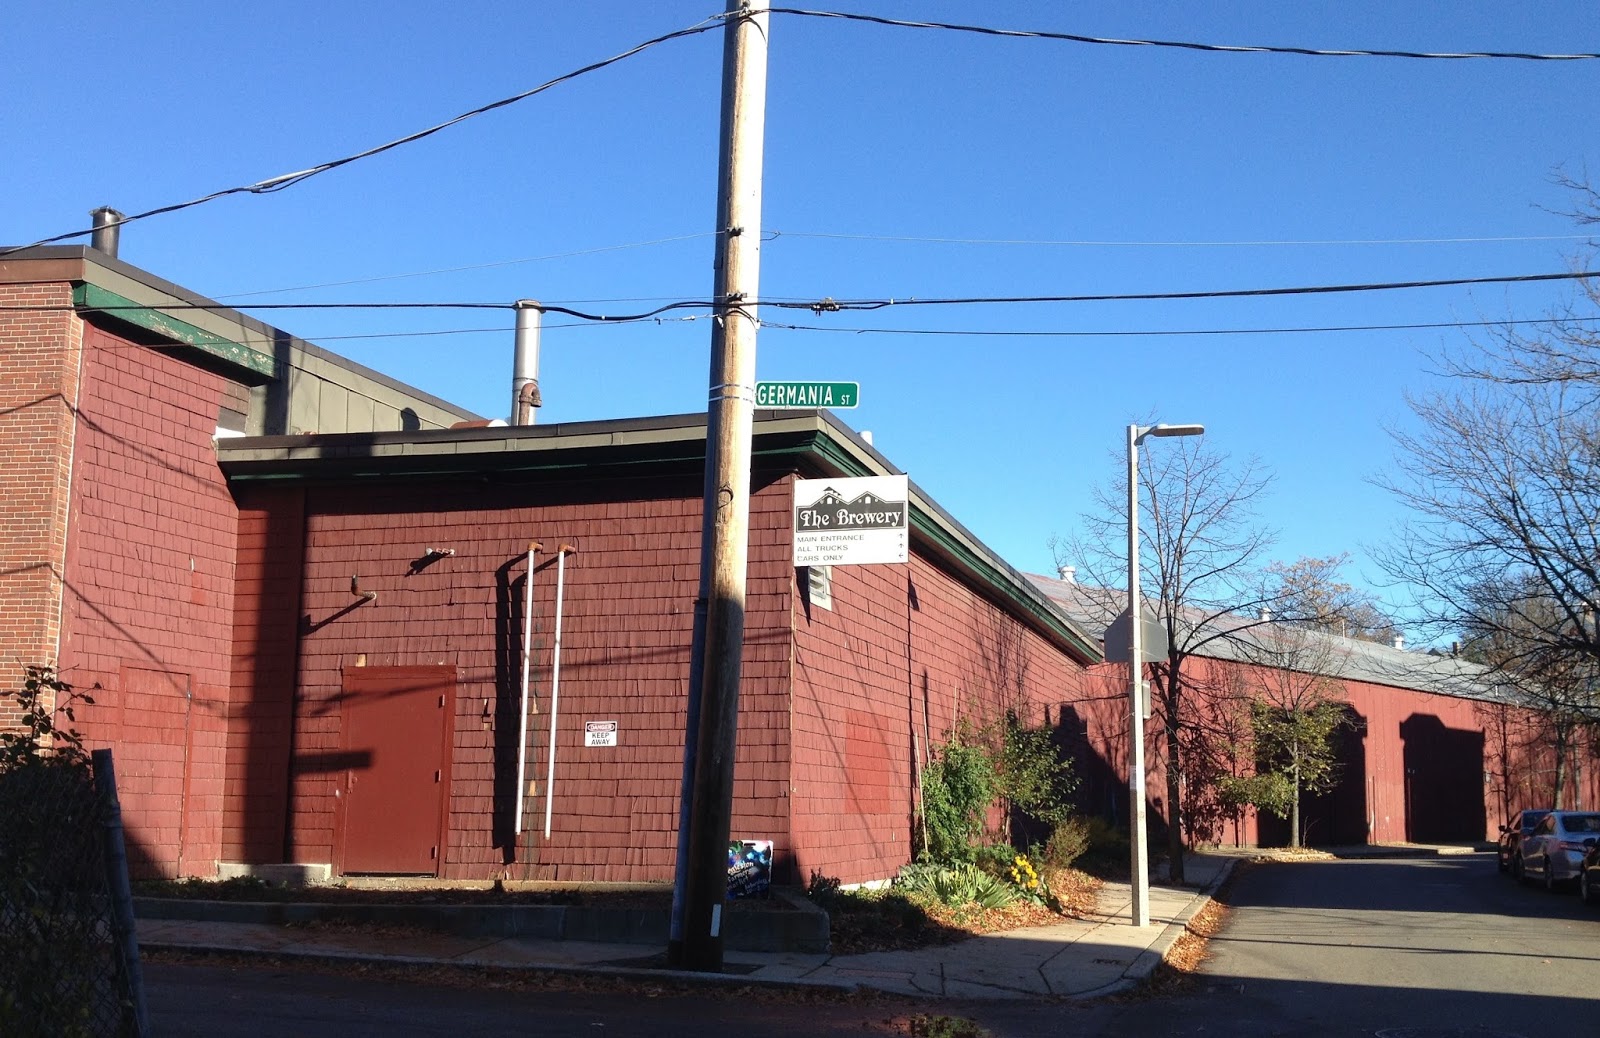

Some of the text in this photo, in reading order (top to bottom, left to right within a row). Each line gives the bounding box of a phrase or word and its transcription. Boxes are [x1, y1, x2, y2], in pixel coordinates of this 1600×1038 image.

[758, 385, 850, 405] GERMANIA ST
[800, 508, 902, 528] The Brewery
[821, 534, 864, 542] ENTRANCE
[816, 544, 848, 552] TRUCKS
